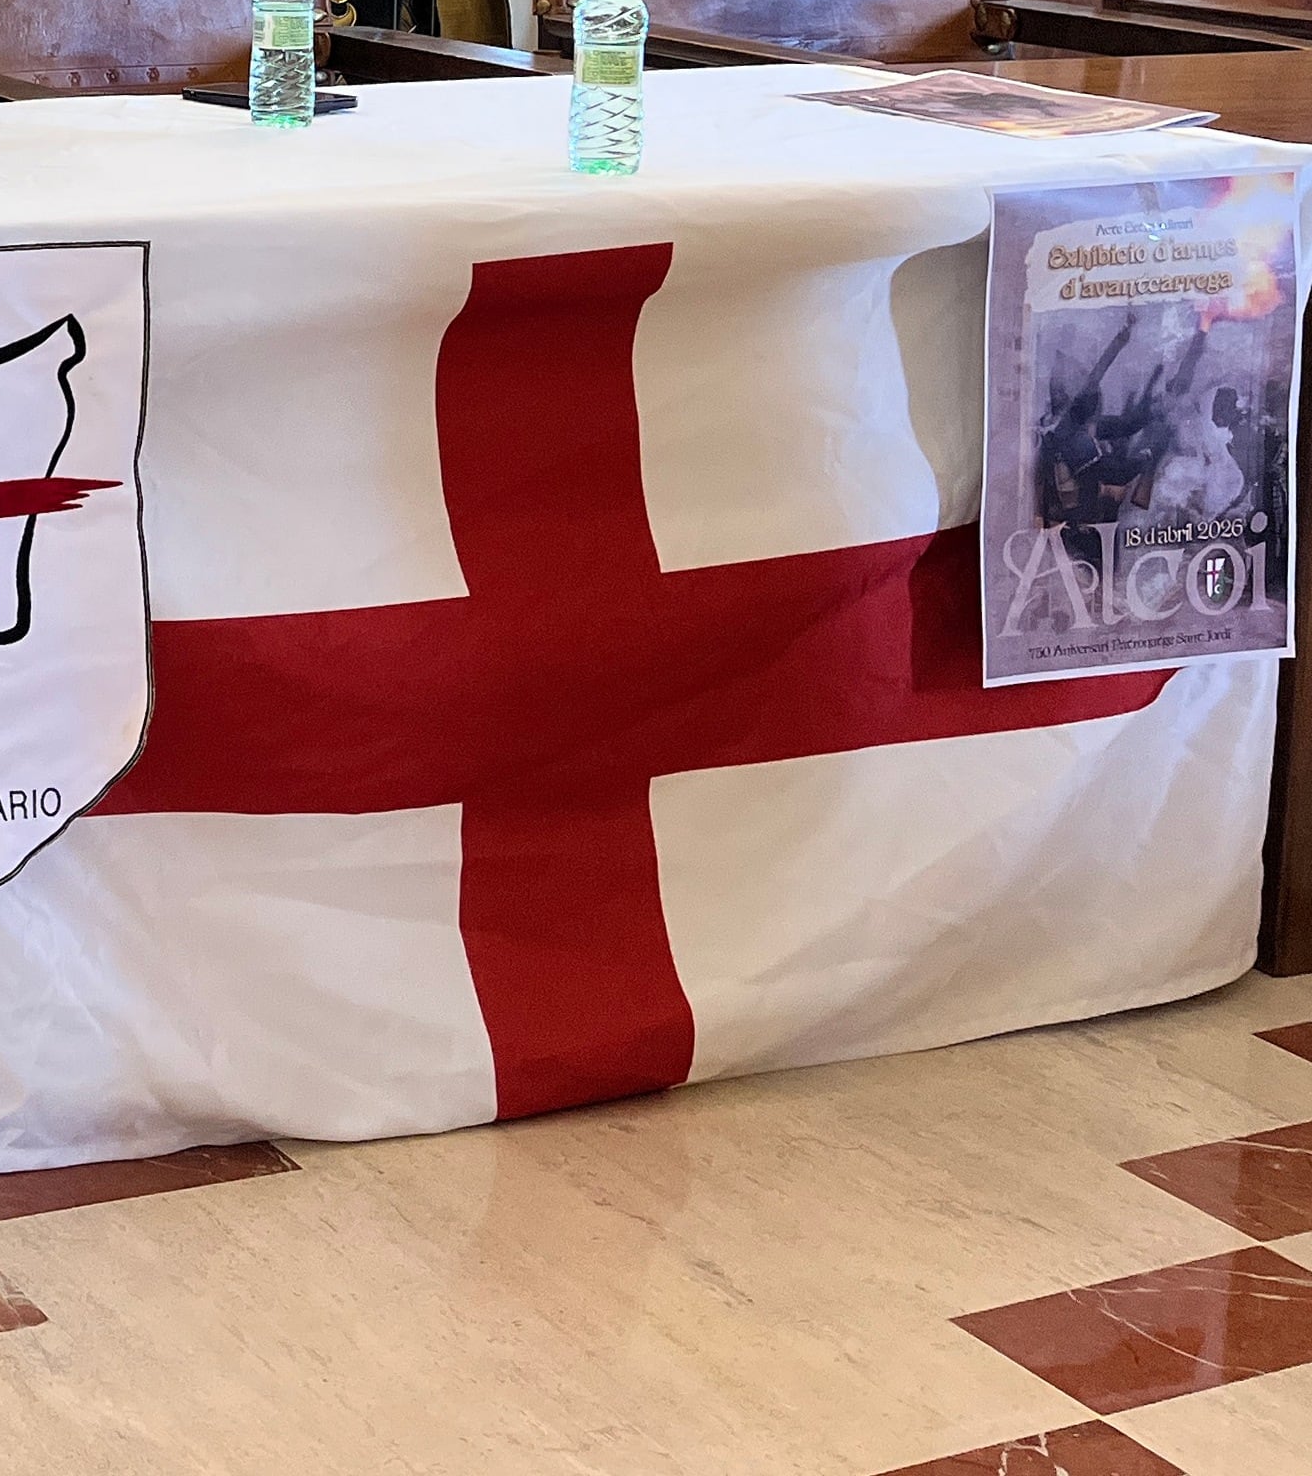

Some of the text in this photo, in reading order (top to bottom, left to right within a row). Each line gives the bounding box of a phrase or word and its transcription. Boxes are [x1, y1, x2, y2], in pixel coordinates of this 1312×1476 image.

[1095, 224, 1123, 237] Acte
[1153, 237, 1237, 262] d'armes
[1060, 270, 1233, 300] d'avantcarrega
[1125, 518, 1244, 547] 18 d'abril 2026
[996, 511, 1275, 638] Alcoi
[1028, 627, 1232, 660] 750 Aniversari Patronatge Sant Jordi
